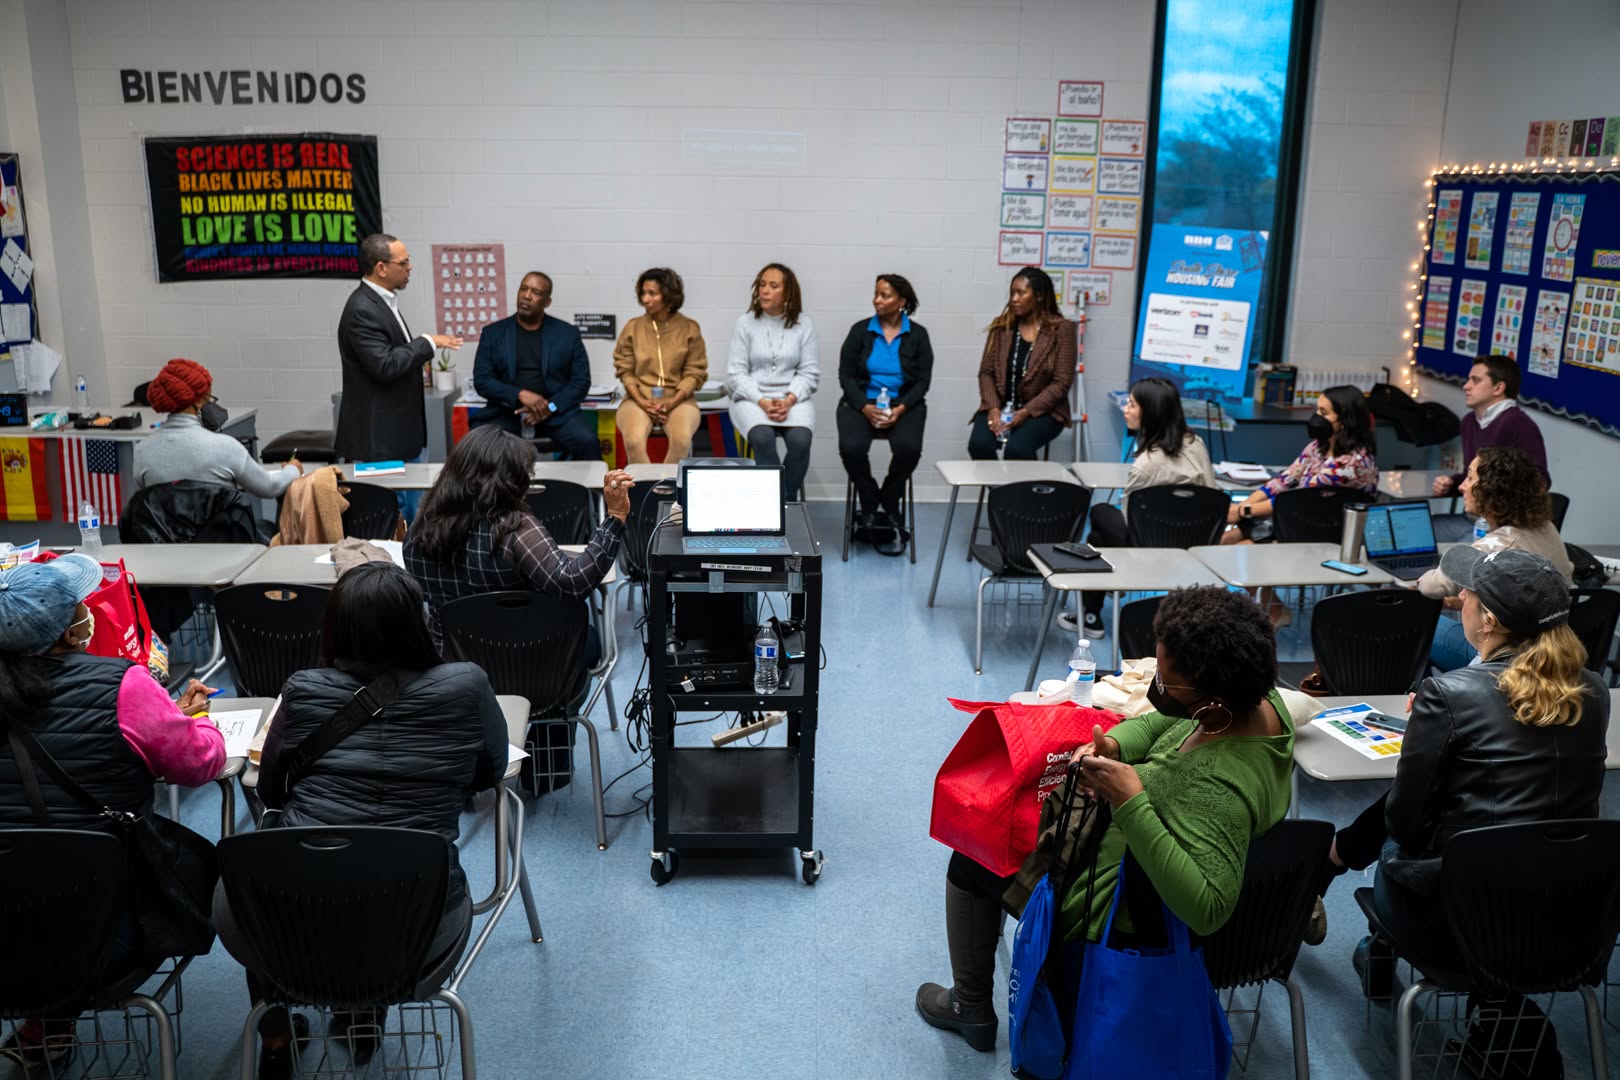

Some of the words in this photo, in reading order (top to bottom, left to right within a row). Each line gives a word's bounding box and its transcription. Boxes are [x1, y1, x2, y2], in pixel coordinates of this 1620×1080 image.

[120, 69, 366, 104] BIENVENIDOS
[1559, 122, 1568, 135] Cc
[176, 144, 267, 172] SCIENCE
[273, 143, 294, 168] IS
[300, 142, 352, 170] REAL
[179, 172, 233, 192] BLACK
[237, 171, 283, 190] LIVES
[287, 171, 353, 190] MATTER
[181, 196, 203, 214] NO
[208, 194, 266, 213] HUMAN
[271, 194, 287, 211] IS
[292, 193, 354, 212] ILLEGAL
[182, 215, 246, 245] LOVE
[254, 214, 283, 242] IS
[291, 213, 357, 243] LOVE
[186, 258, 252, 272] KINDNESS
[257, 258, 270, 271] IS
[274, 257, 359, 272] EVERYTHING
[1166, 273, 1209, 286] HOUSING
[1211, 276, 1236, 288] FAIR
[1151, 308, 1181, 316] verizon
